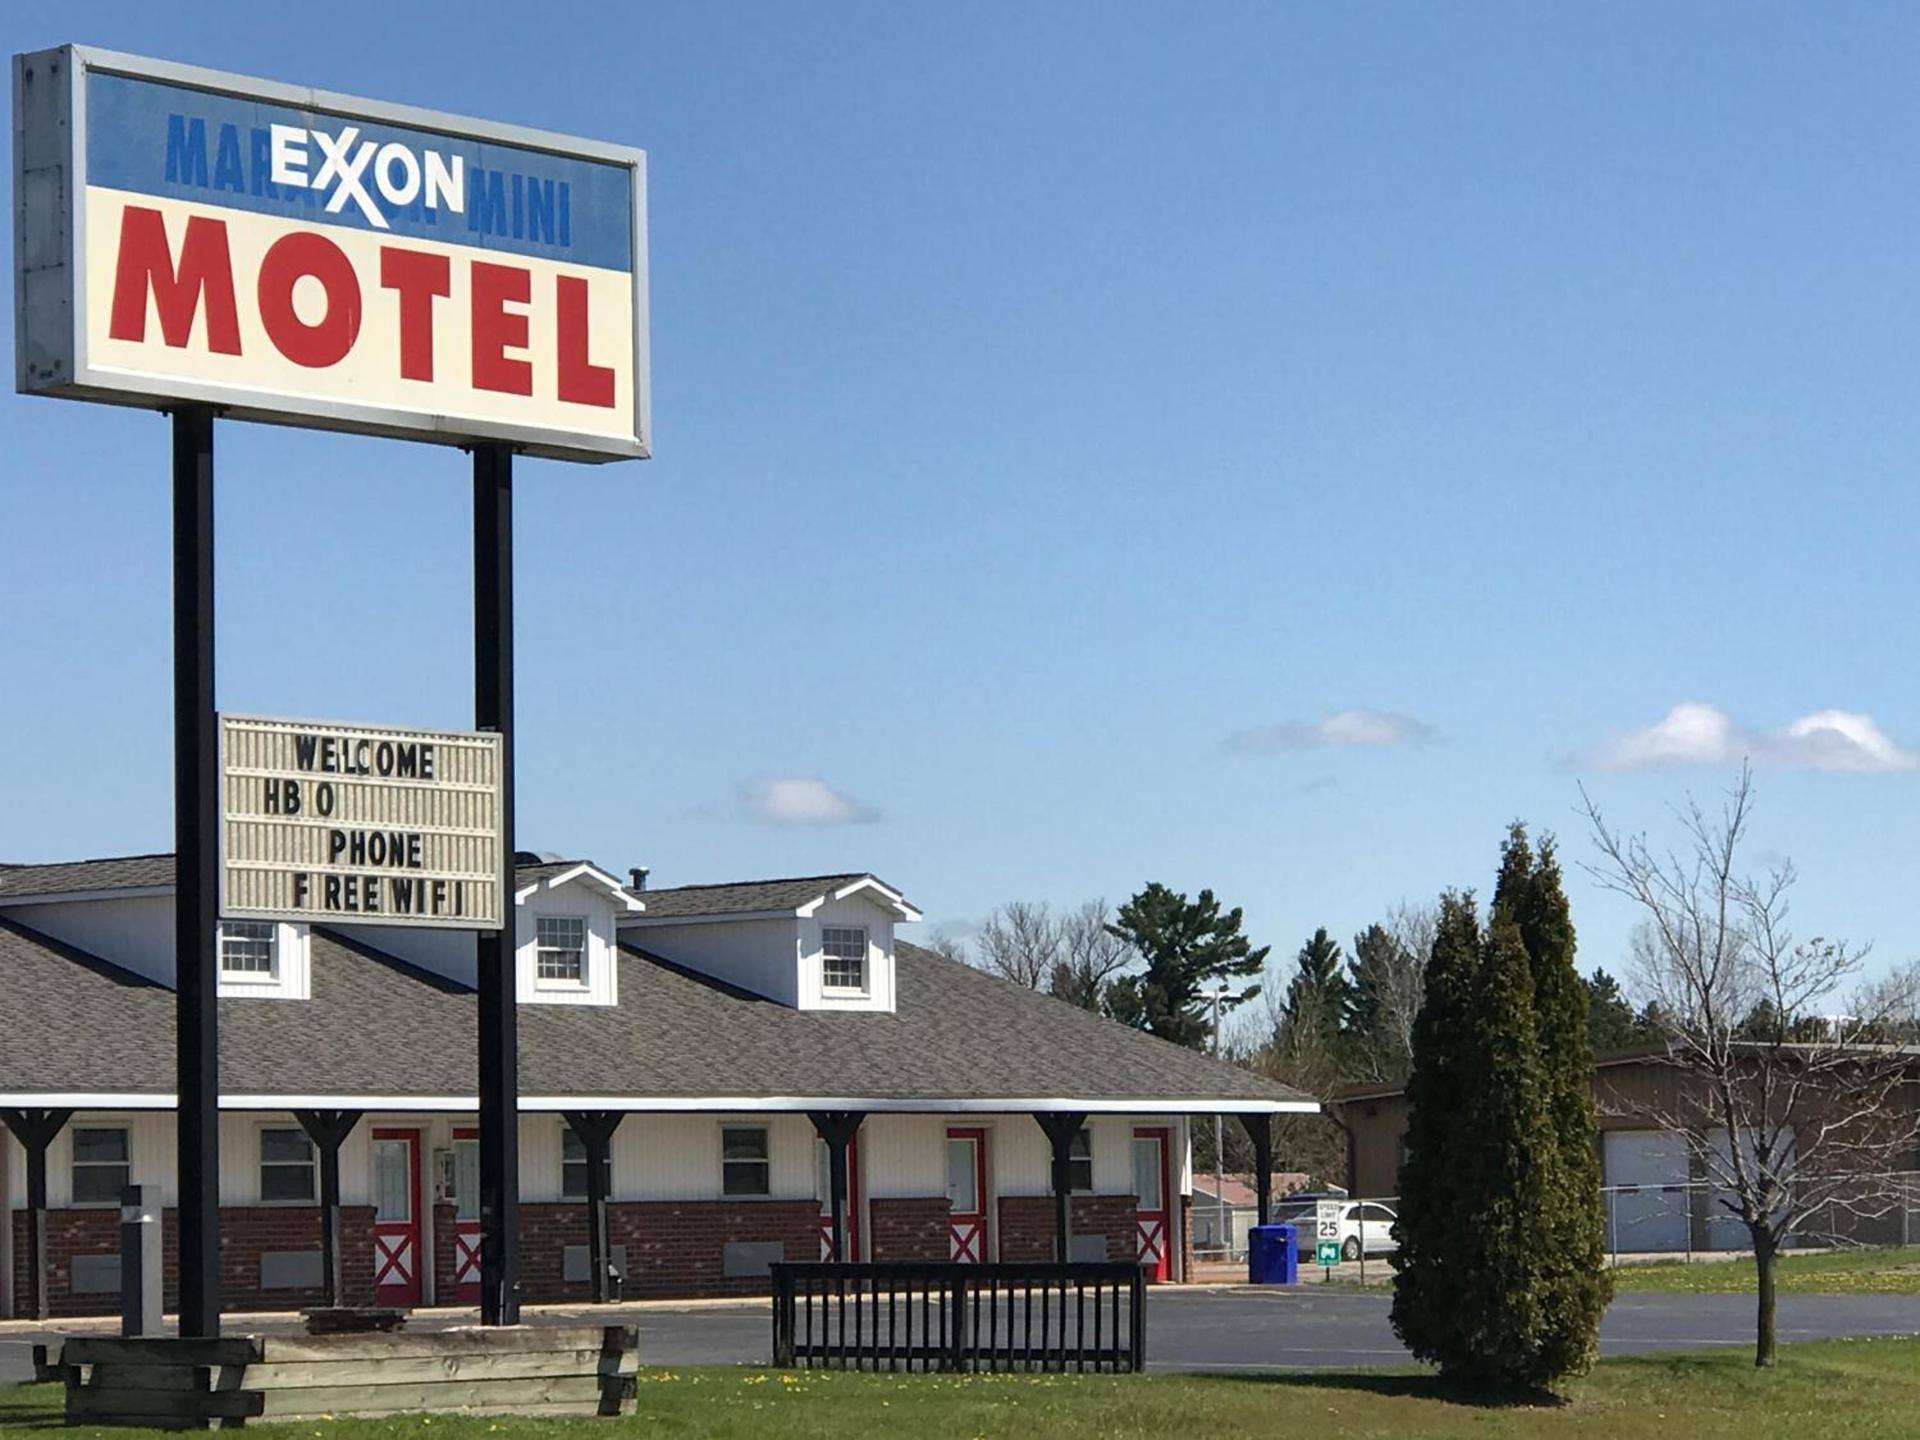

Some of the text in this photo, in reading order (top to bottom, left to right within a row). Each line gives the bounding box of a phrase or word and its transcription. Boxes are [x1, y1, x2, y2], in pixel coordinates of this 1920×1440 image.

[270, 123, 464, 229] EXXON
[468, 167, 571, 247] MINI
[109, 205, 616, 409] MOTEL
[295, 735, 434, 779] WELCOME
[329, 830, 422, 868] PHONE
[294, 874, 463, 916] FREE WIFI
[1320, 1221, 1338, 1237] 25
